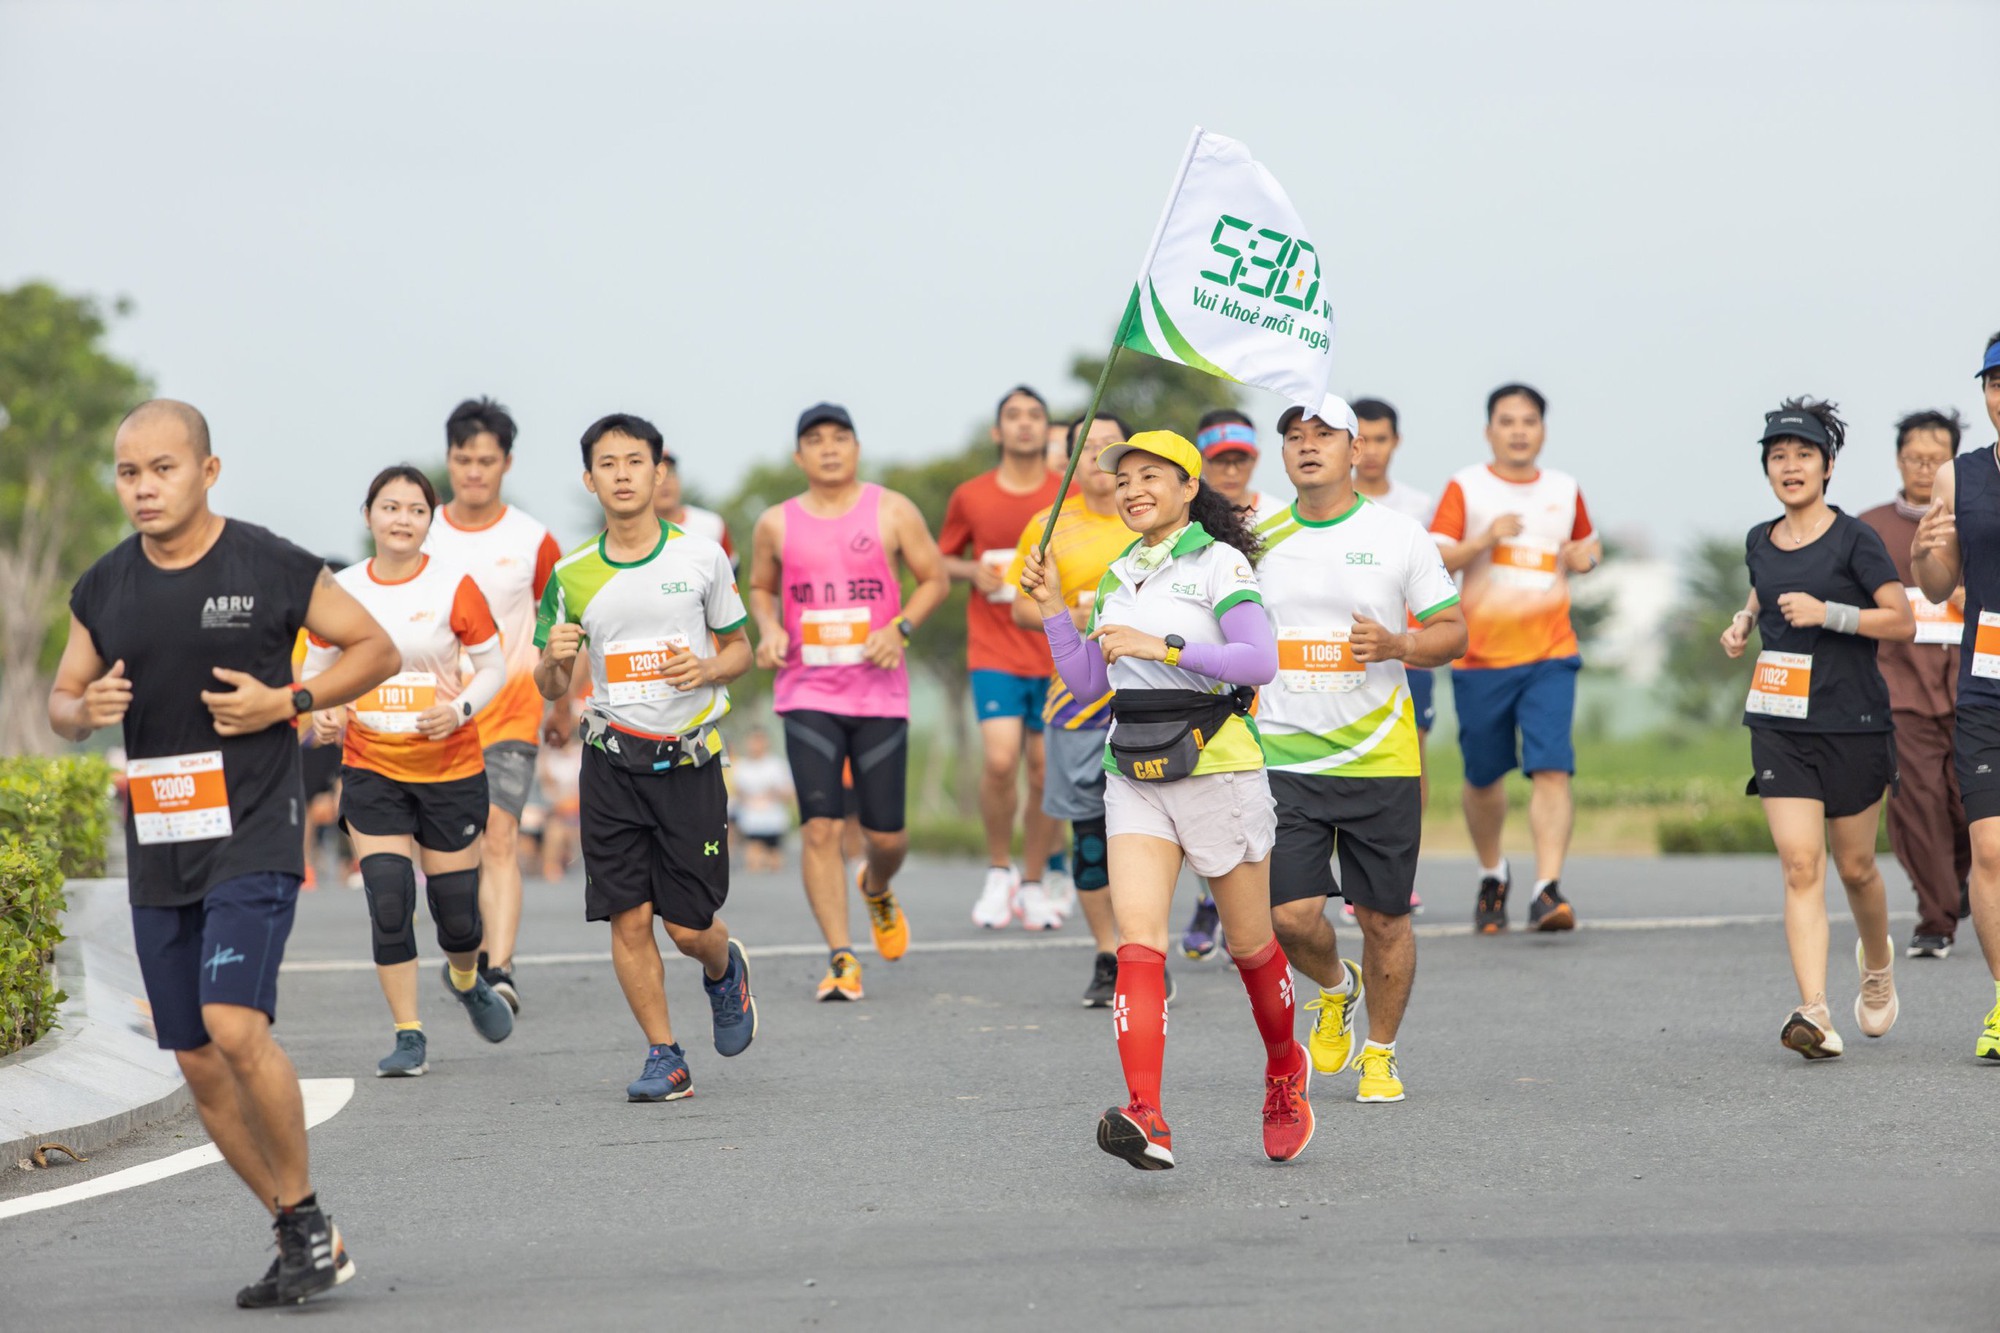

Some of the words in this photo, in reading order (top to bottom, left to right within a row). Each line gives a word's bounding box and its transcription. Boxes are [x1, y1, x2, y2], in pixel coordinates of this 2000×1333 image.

[1193, 286, 1219, 311] Vui
[1220, 297, 1260, 325] khoẻ
[1261, 314, 1295, 336] mỗi
[202, 595, 255, 613] ASRU
[628, 652, 668, 672] 12031
[1301, 644, 1343, 662] 11065
[377, 686, 415, 705] 11011
[151, 774, 196, 802] 12009
